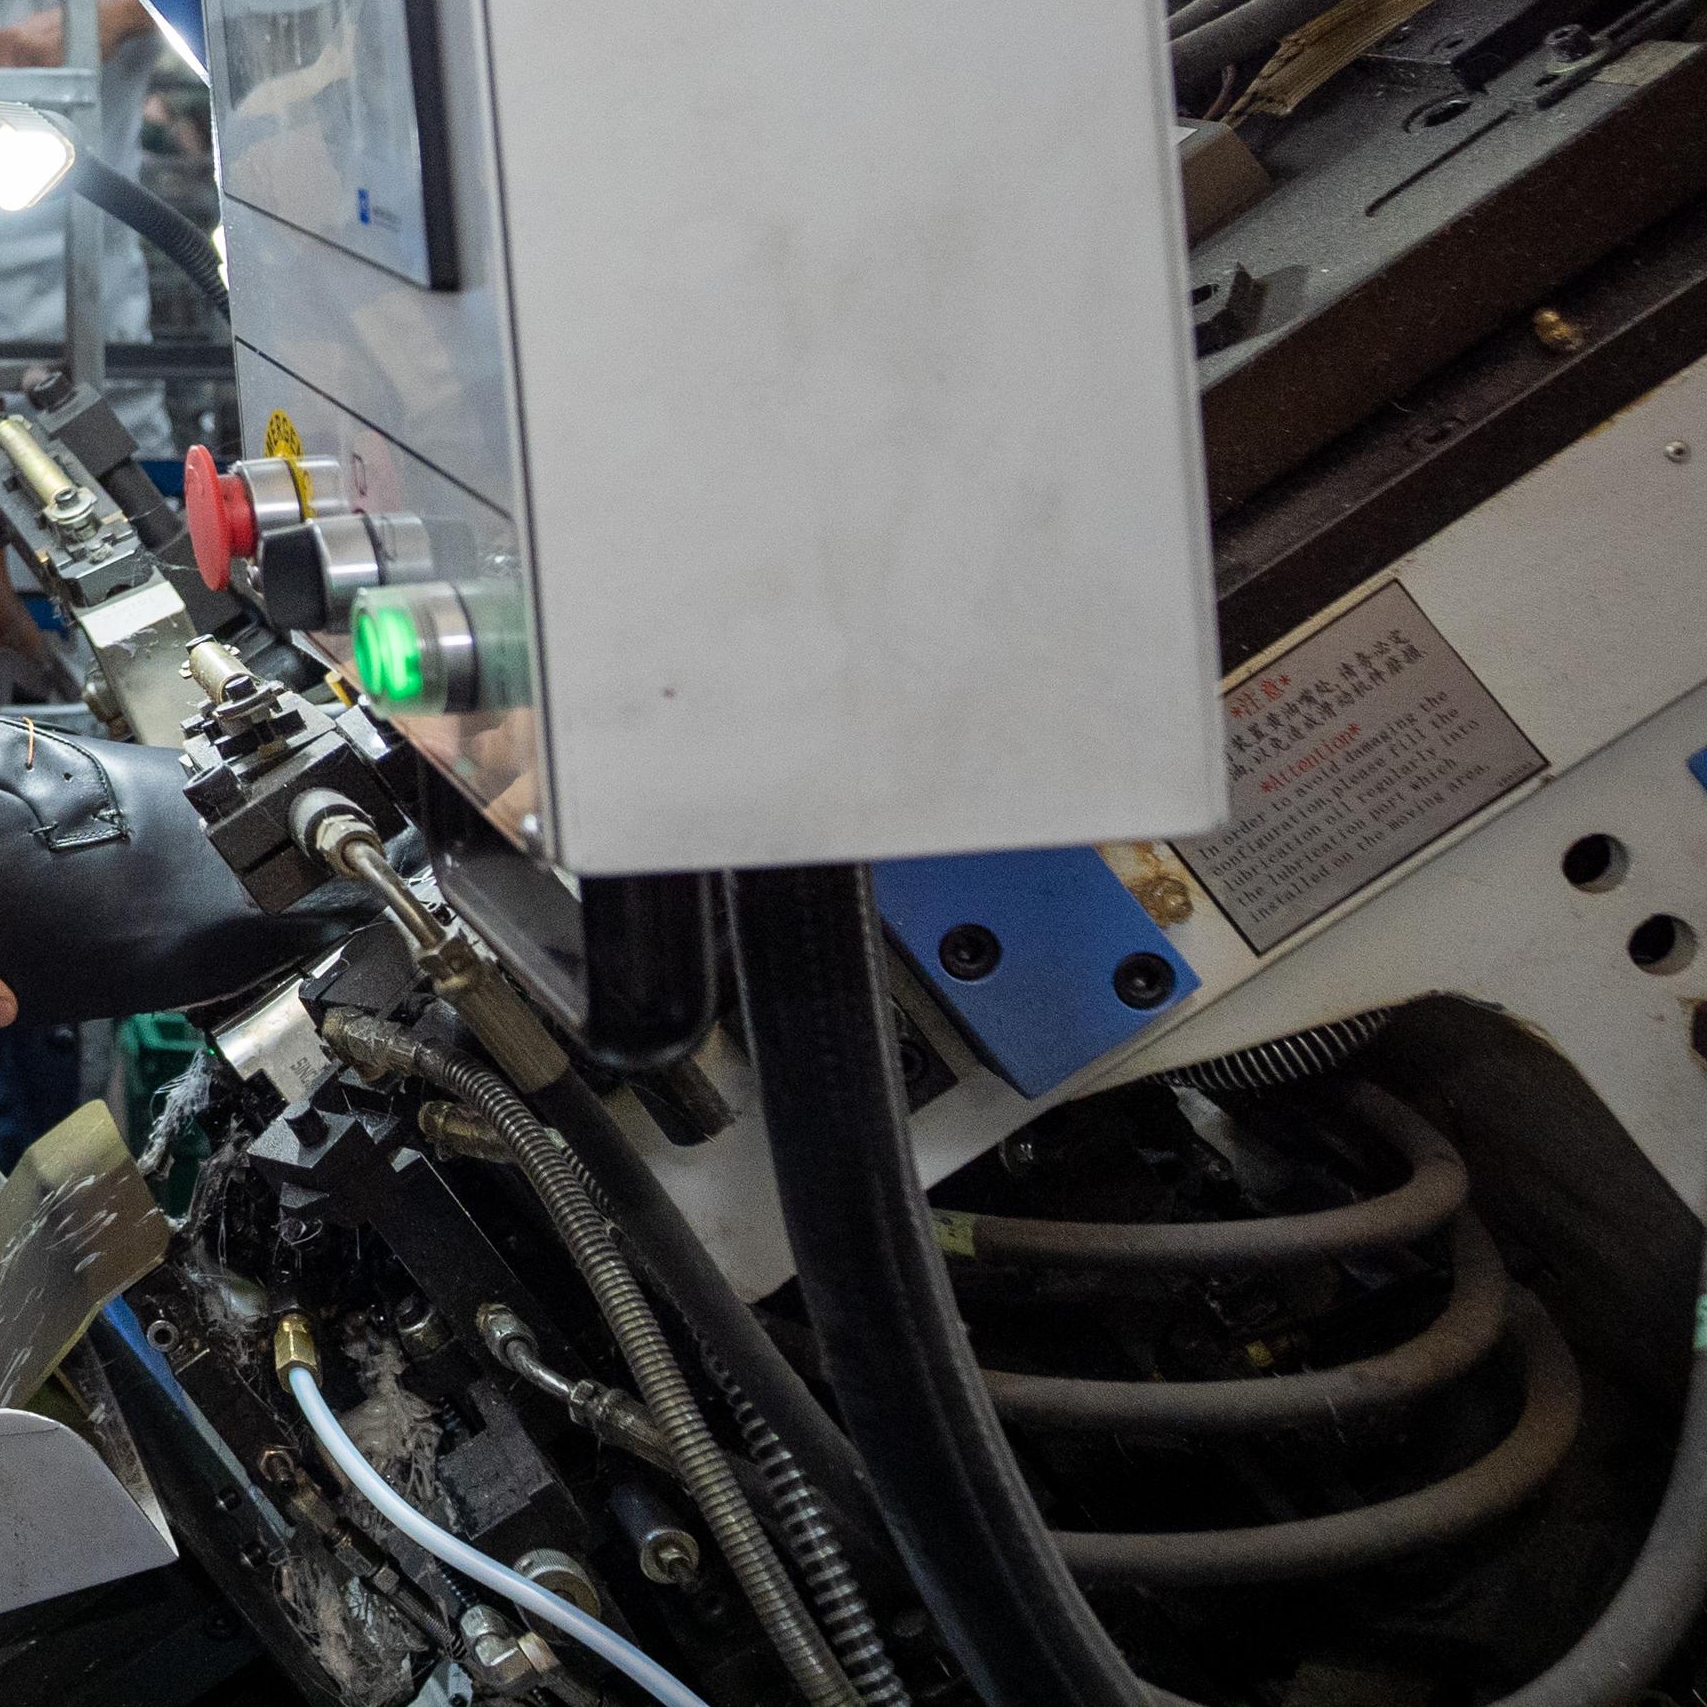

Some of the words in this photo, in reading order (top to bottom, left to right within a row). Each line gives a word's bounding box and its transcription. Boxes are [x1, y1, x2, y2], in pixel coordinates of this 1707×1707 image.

[1197, 845, 1220, 860] In
[1222, 811, 1265, 845] order
[1270, 796, 1291, 811] to
[1294, 760, 1340, 797] avoid
[1344, 713, 1417, 763] damaging
[1418, 691, 1447, 712] the
[1223, 825, 1321, 891] lubrication
[1324, 801, 1353, 824] oil
[1356, 747, 1436, 803] regularly
[1440, 719, 1479, 746] into
[1389, 727, 1426, 757] fill
[1428, 708, 1458, 729] the
[1236, 886, 1263, 906] the
[1267, 819, 1366, 886] lubrication
[1368, 791, 1405, 821] port
[1409, 758, 1457, 791] which
[1249, 864, 1330, 923] installed
[1332, 851, 1354, 867] on
[1356, 830, 1383, 851] the
[1386, 791, 1444, 831] moving
